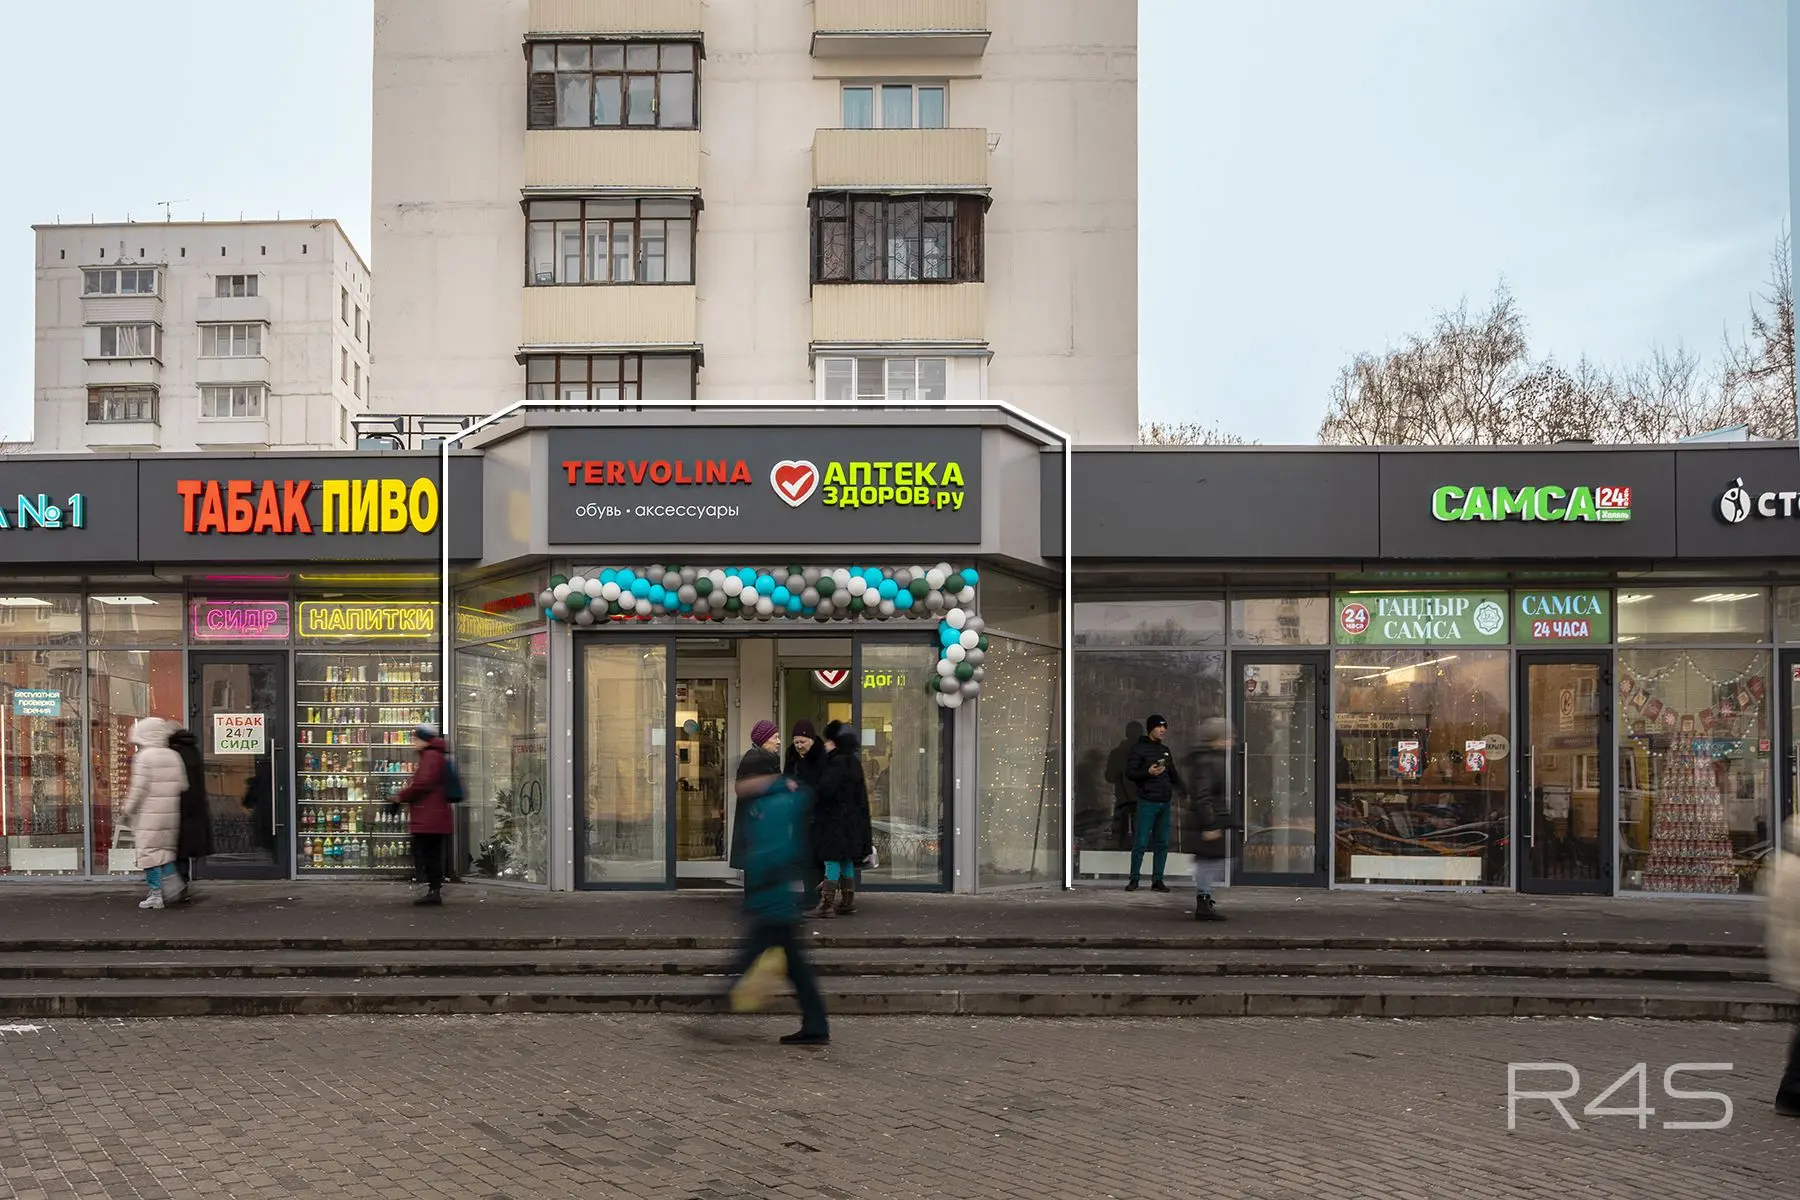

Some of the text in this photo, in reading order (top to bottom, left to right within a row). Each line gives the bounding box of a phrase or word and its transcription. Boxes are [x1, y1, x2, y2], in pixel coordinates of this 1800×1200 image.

[562, 460, 752, 485] TERVOLINA
[823, 462, 965, 486] АПТЕКА
[177, 477, 439, 533] ТАБАК ПИВО
[823, 486, 965, 510] ЗДОРОВ.ру
[1433, 485, 1597, 521] САМСА
[1601, 487, 1624, 506] 24
[1757, 491, 1800, 518] СТ
[575, 503, 739, 519] обувь аксессуары
[1344, 608, 1366, 623] 24
[1377, 598, 1470, 620] ТАНДЫР
[1521, 595, 1602, 616] САМСА
[207, 609, 278, 633] СИДР
[309, 608, 434, 631] НАПИТКИ
[1383, 620, 1463, 639] САМСА
[1534, 621, 1589, 638] 24 ЧАСА
[216, 717, 262, 726] ТАБАК
[225, 728, 254, 738] 24/7
[220, 739, 259, 750] СИДР
